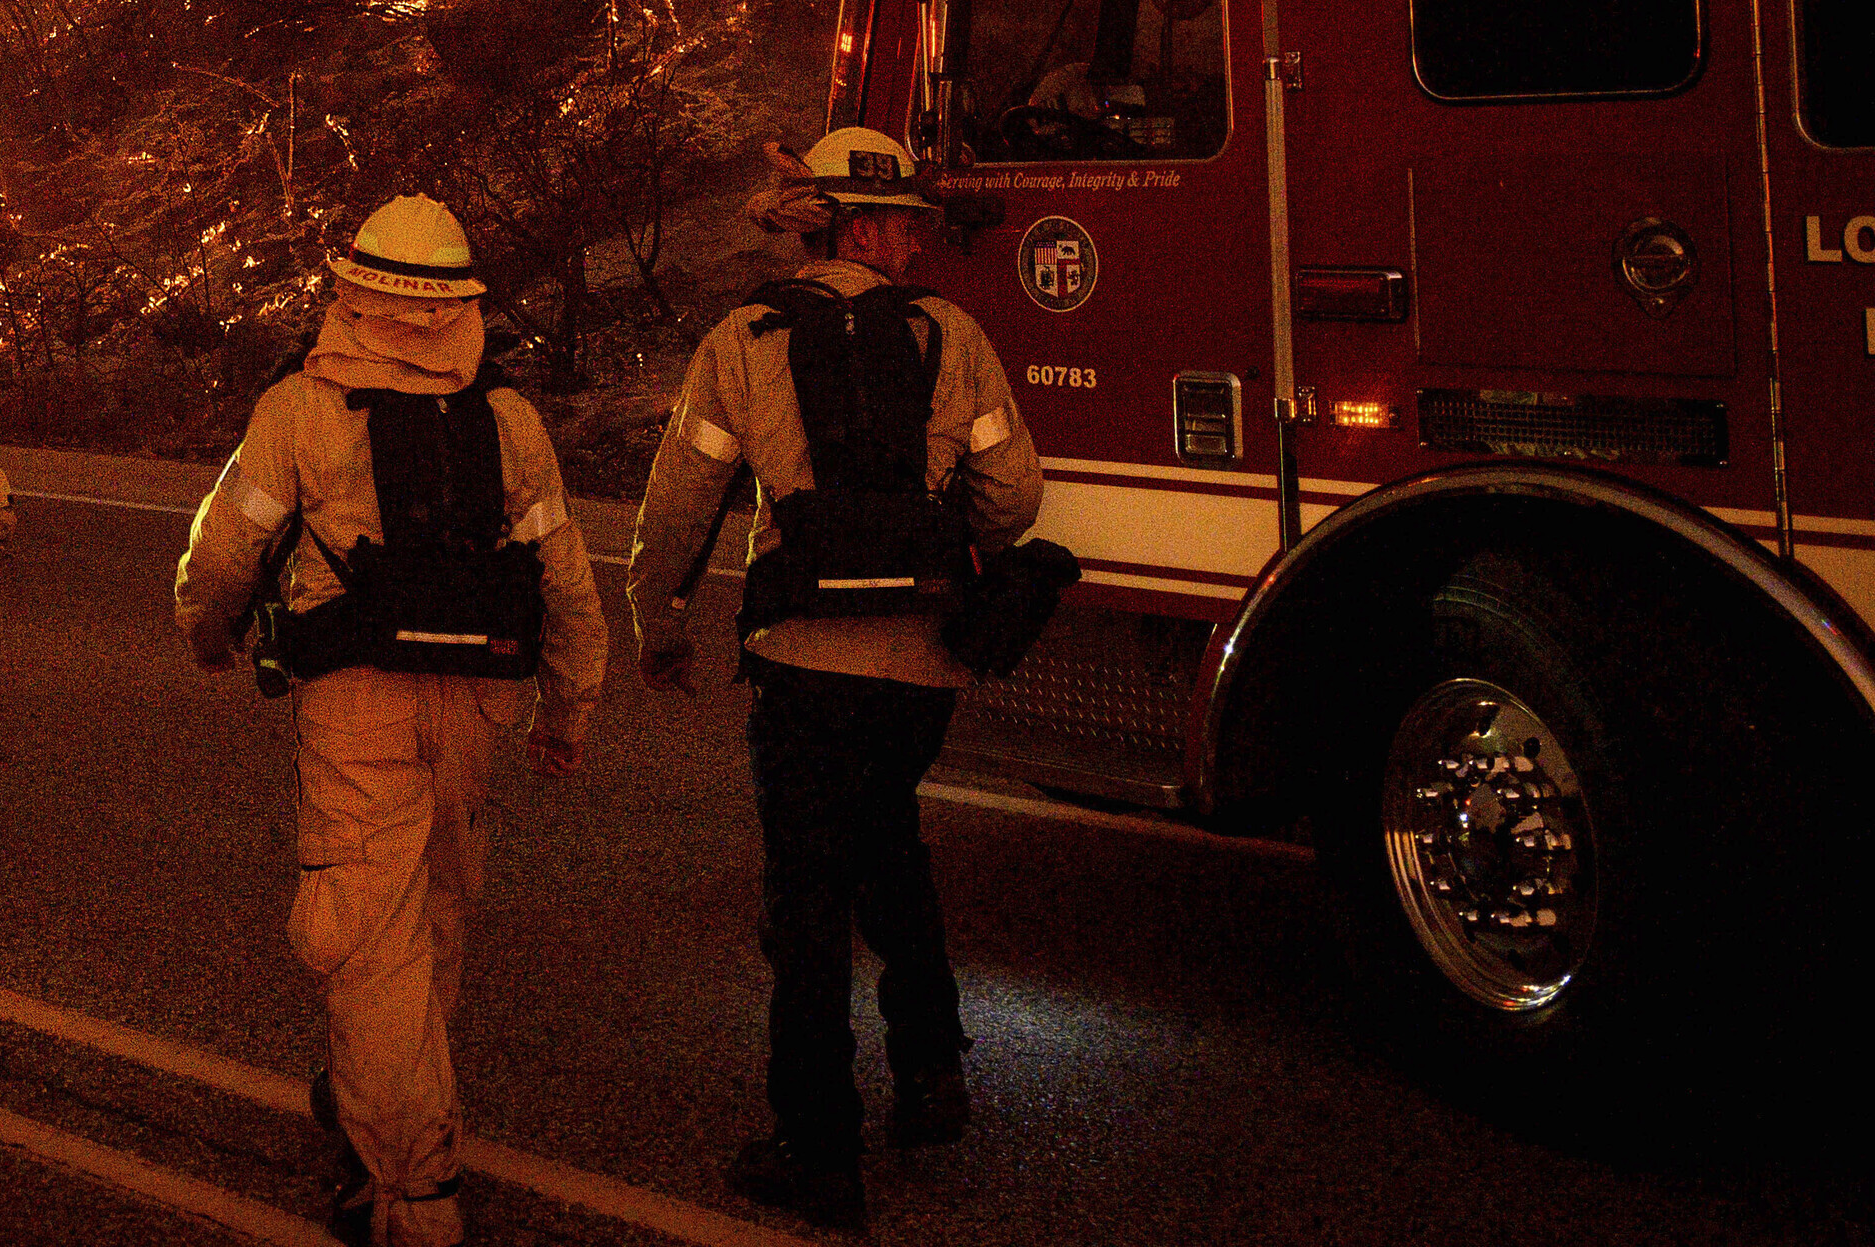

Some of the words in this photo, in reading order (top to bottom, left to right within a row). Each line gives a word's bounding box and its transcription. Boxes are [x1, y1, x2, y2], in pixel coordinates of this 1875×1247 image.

[855, 152, 894, 182] 39
[985, 171, 1011, 189] with
[1013, 171, 1066, 191] Courage,
[1068, 170, 1125, 192] Integrity
[1126, 170, 1140, 188] &
[1142, 169, 1181, 188] Pride
[1026, 363, 1098, 389] 60783
